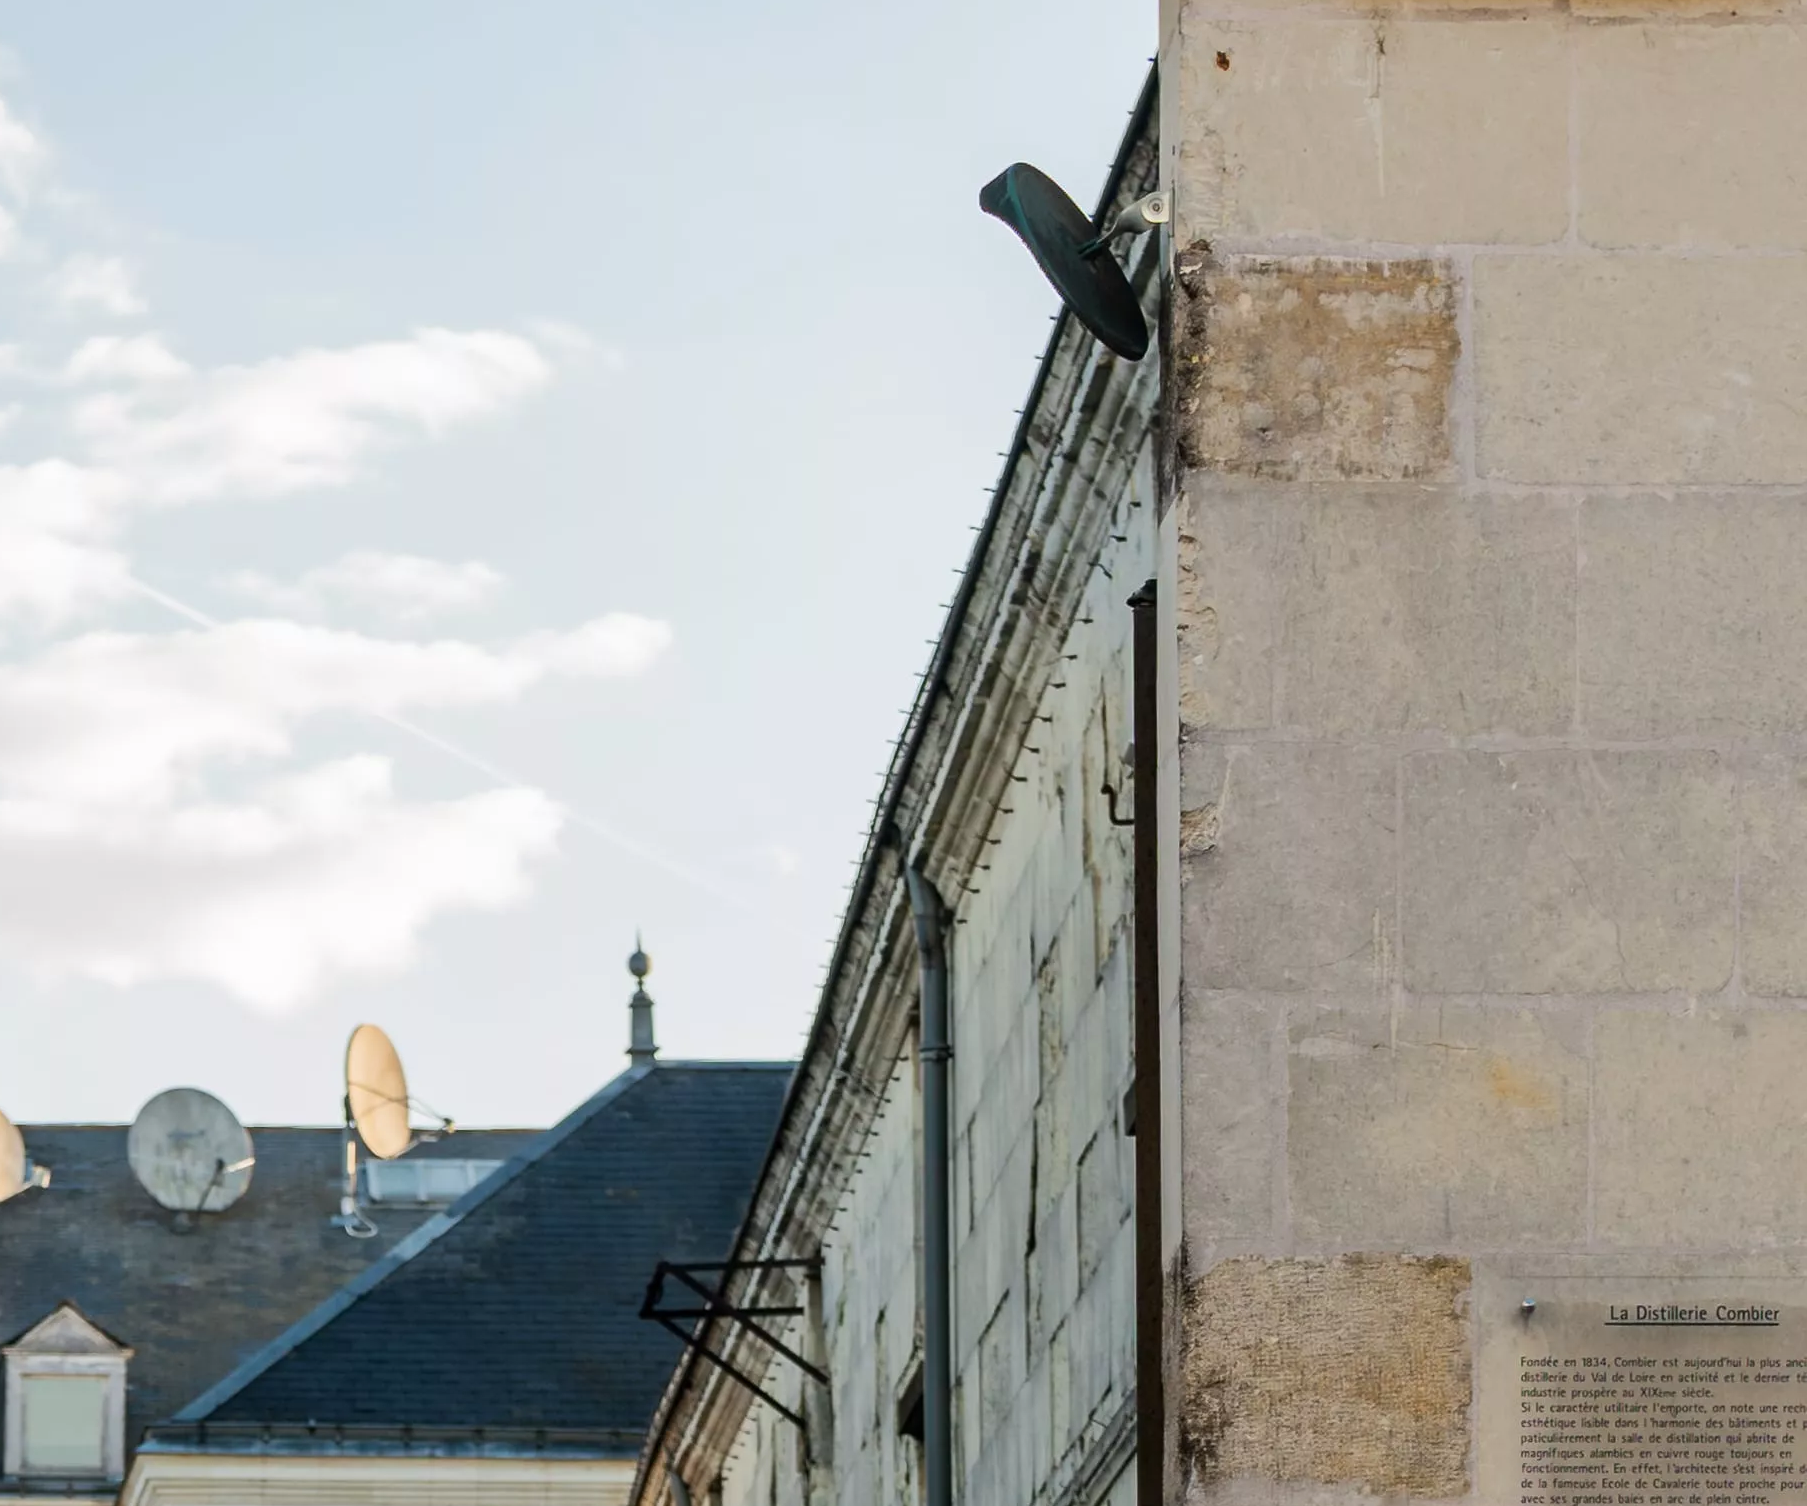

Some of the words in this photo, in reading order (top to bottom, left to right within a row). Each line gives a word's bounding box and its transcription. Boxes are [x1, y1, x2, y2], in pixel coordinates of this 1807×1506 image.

[1610, 1305, 1628, 1321] La
[1636, 1305, 1707, 1321] Distillerie
[1716, 1305, 1780, 1321] Combier
[1520, 1356, 1559, 1367] Fondée
[1614, 1356, 1657, 1367] Combier
[1662, 1356, 1678, 1367] est
[1684, 1356, 1742, 1369] aujourd'hui
[1760, 1356, 1781, 1369] plus
[1520, 1371, 1567, 1383] distillerie
[1591, 1371, 1607, 1383] Val
[1629, 1371, 1655, 1383] Loire
[1678, 1371, 1718, 1383] activité
[1754, 1371, 1790, 1383] dernier
[1521, 1387, 1566, 1398] industrie
[1571, 1387, 1617, 1400] prospère
[1682, 1387, 1714, 1398] siècle.
[1550, 1402, 1599, 1413] caractère
[1604, 1402, 1648, 1413] utilitaire
[1731, 1402, 1754, 1413] note
[1759, 1404, 1778, 1413] une
[1521, 1417, 1576, 1430] esthétique
[1581, 1417, 1609, 1428] lisible
[1615, 1417, 1639, 1428] dans
[1705, 1417, 1724, 1428] des
[1729, 1417, 1781, 1428] bâtiments
[1621, 1432, 1643, 1444] salle
[1666, 1432, 1721, 1444] distillation
[1726, 1432, 1742, 1446] qui
[1747, 1432, 1777, 1444] abrite
[1521, 1448, 1585, 1461] magnifiques
[1590, 1448, 1634, 1459] alambics
[1658, 1448, 1689, 1459] cuivre
[1695, 1450, 1725, 1461] rouge
[1731, 1448, 1774, 1461] toujours
[1632, 1463, 1662, 1476] effet,
[1733, 1463, 1755, 1474] s'est
[1761, 1463, 1794, 1476] inspiré
[1553, 1478, 1596, 1489] fameuse
[1602, 1478, 1630, 1489] Ecole
[1653, 1478, 1700, 1489] Cavalerie
[1706, 1478, 1734, 1489] toute
[1739, 1478, 1775, 1491] proche
[1780, 1480, 1804, 1491] pour
[1521, 1494, 1544, 1505] avec
[1550, 1494, 1567, 1505] ses
[1572, 1492, 1613, 1506] grandes
[1618, 1492, 1644, 1505] baies
[1667, 1494, 1684, 1505] arc
[1707, 1492, 1731, 1506] plein
[1736, 1492, 1770, 1505] cintre.
